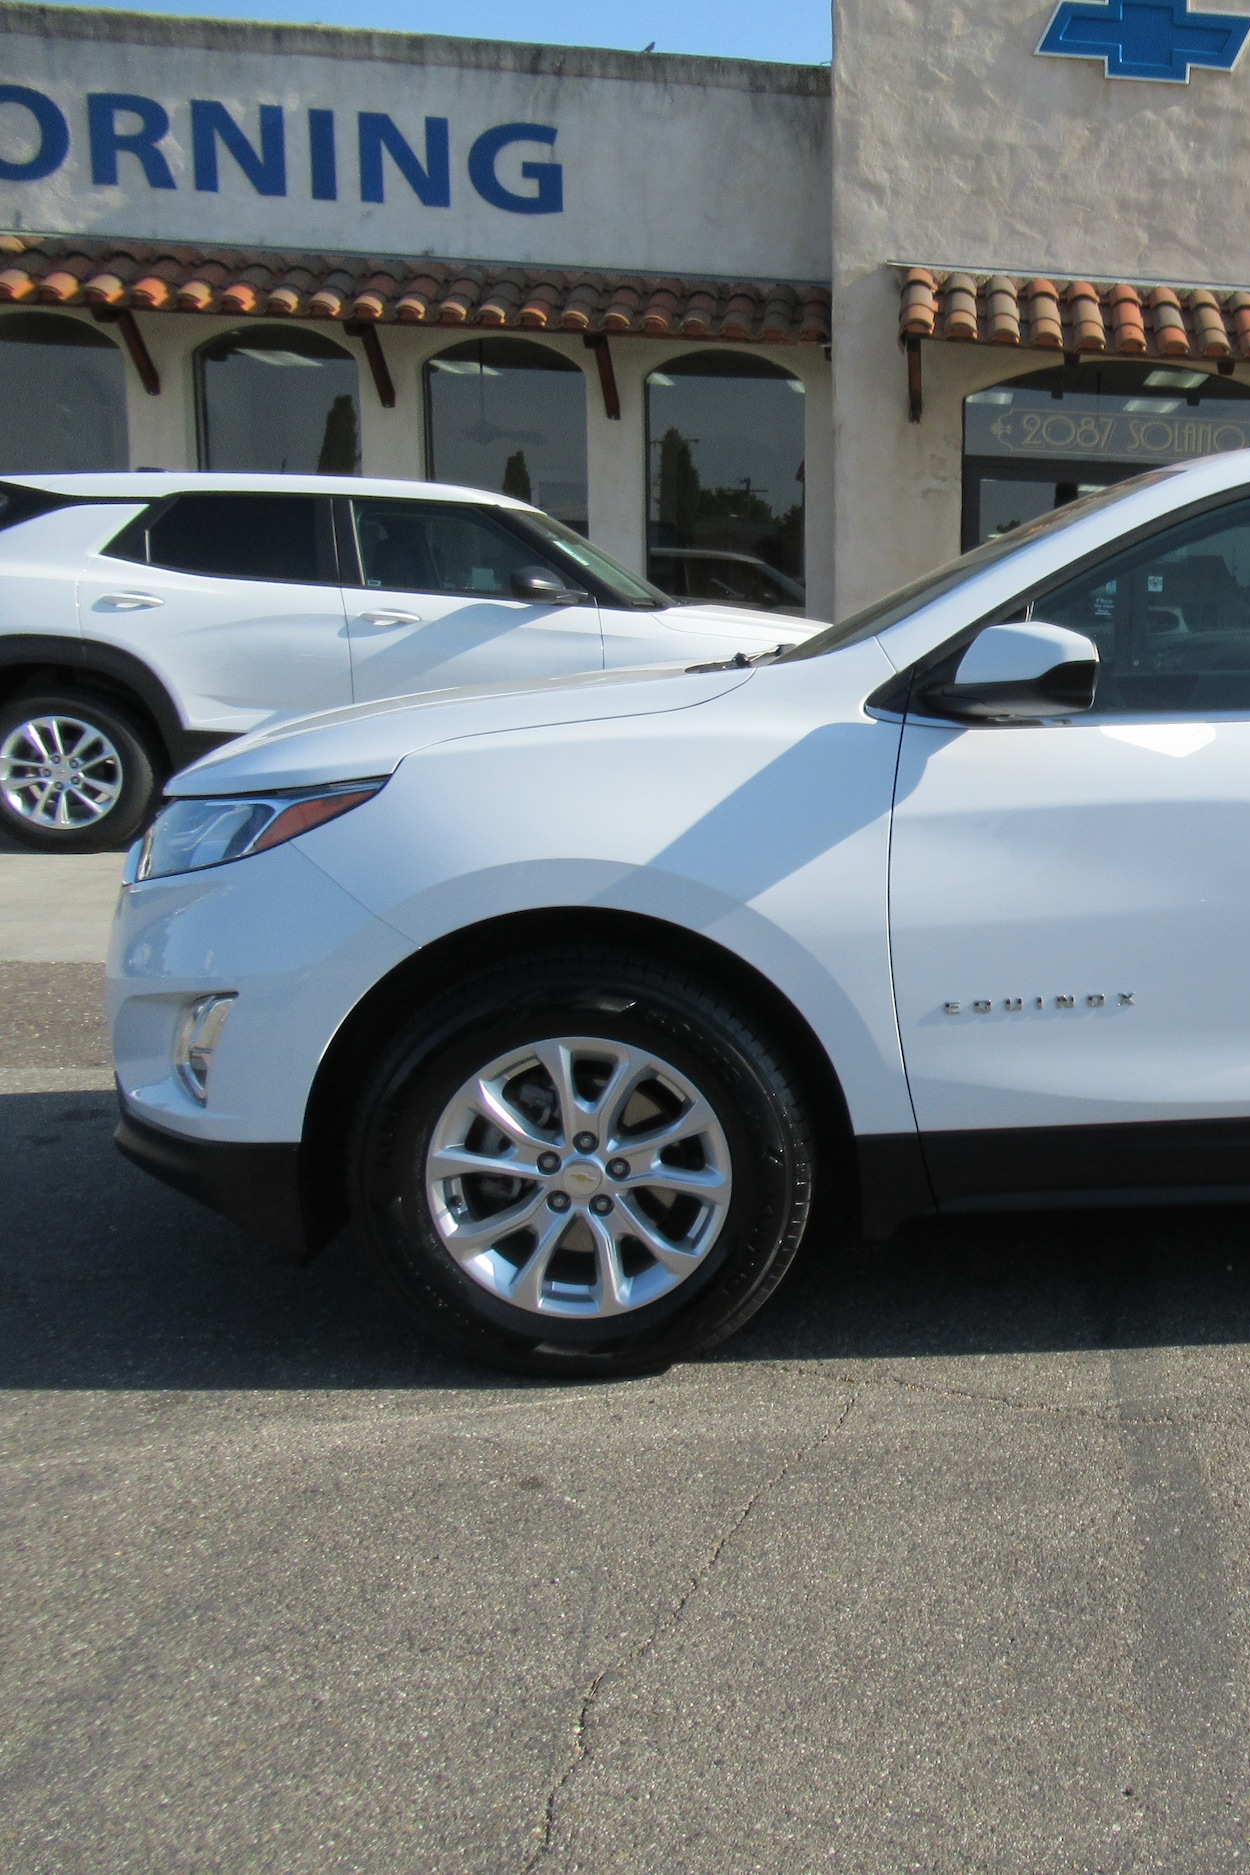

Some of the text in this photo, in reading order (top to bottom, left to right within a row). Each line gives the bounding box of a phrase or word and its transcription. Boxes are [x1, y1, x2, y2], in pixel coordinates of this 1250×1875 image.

[1022, 414, 1246, 454] 2087 SOLANO
[943, 991, 1136, 1016] EQUINOX
